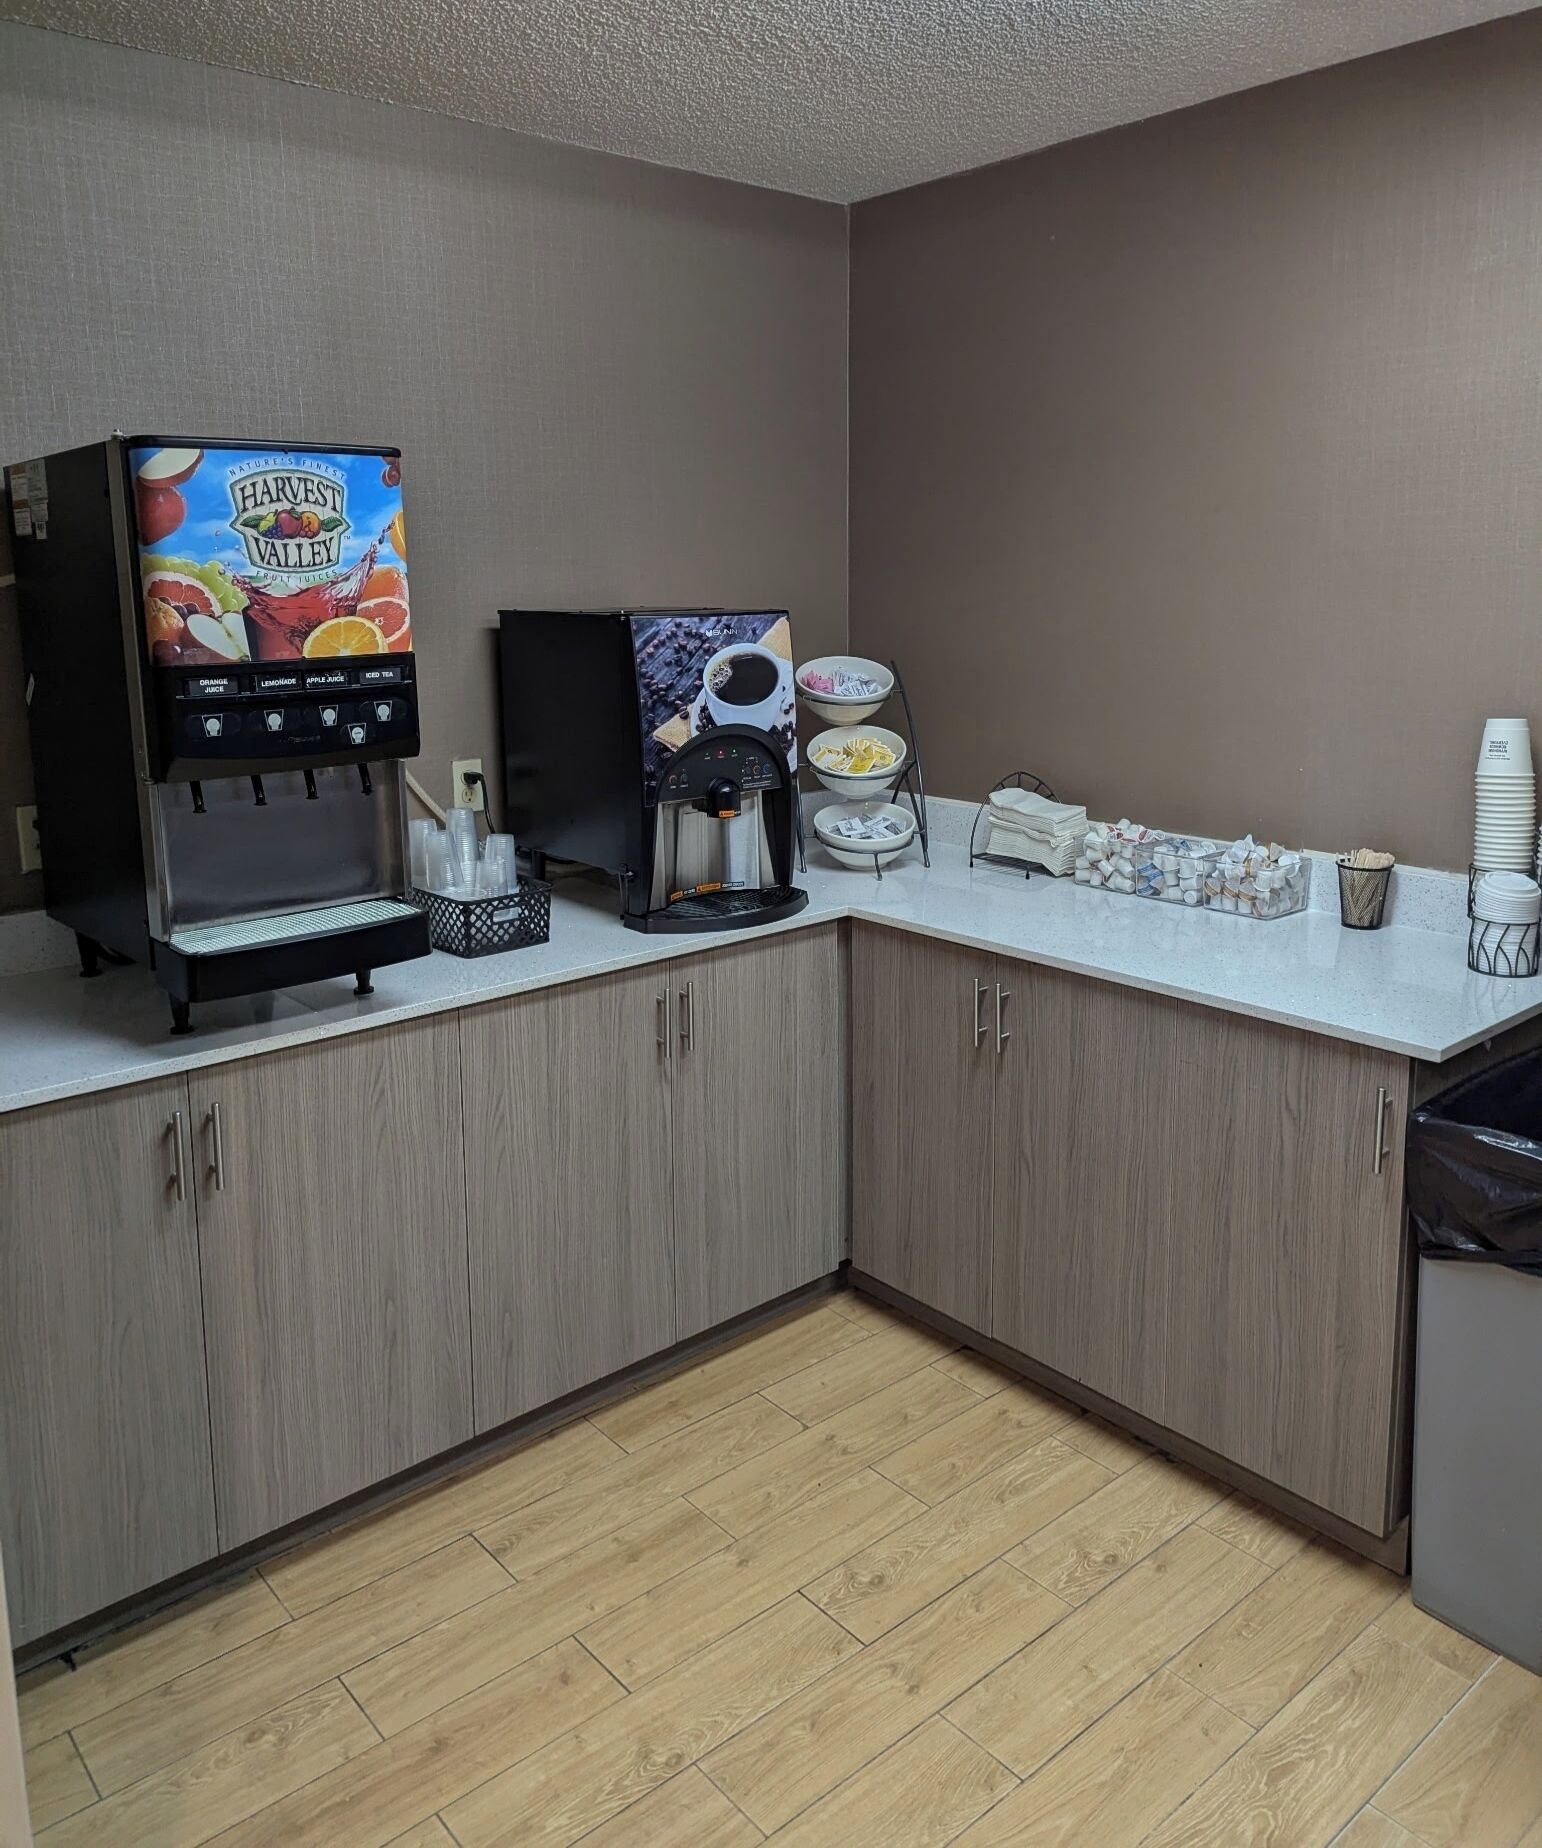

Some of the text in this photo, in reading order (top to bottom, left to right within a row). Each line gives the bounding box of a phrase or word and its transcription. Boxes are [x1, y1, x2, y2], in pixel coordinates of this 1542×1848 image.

[229, 457, 346, 481] NATURE'S FINEST
[239, 476, 341, 513] HARVEST
[251, 535, 336, 567] VALLEY
[256, 569, 338, 583] FRUIT JUICES
[199, 678, 229, 686] ORANGE
[261, 678, 297, 687] LEMONADE
[306, 675, 345, 684] APPLE JUICE
[204, 685, 225, 693] JUICE
